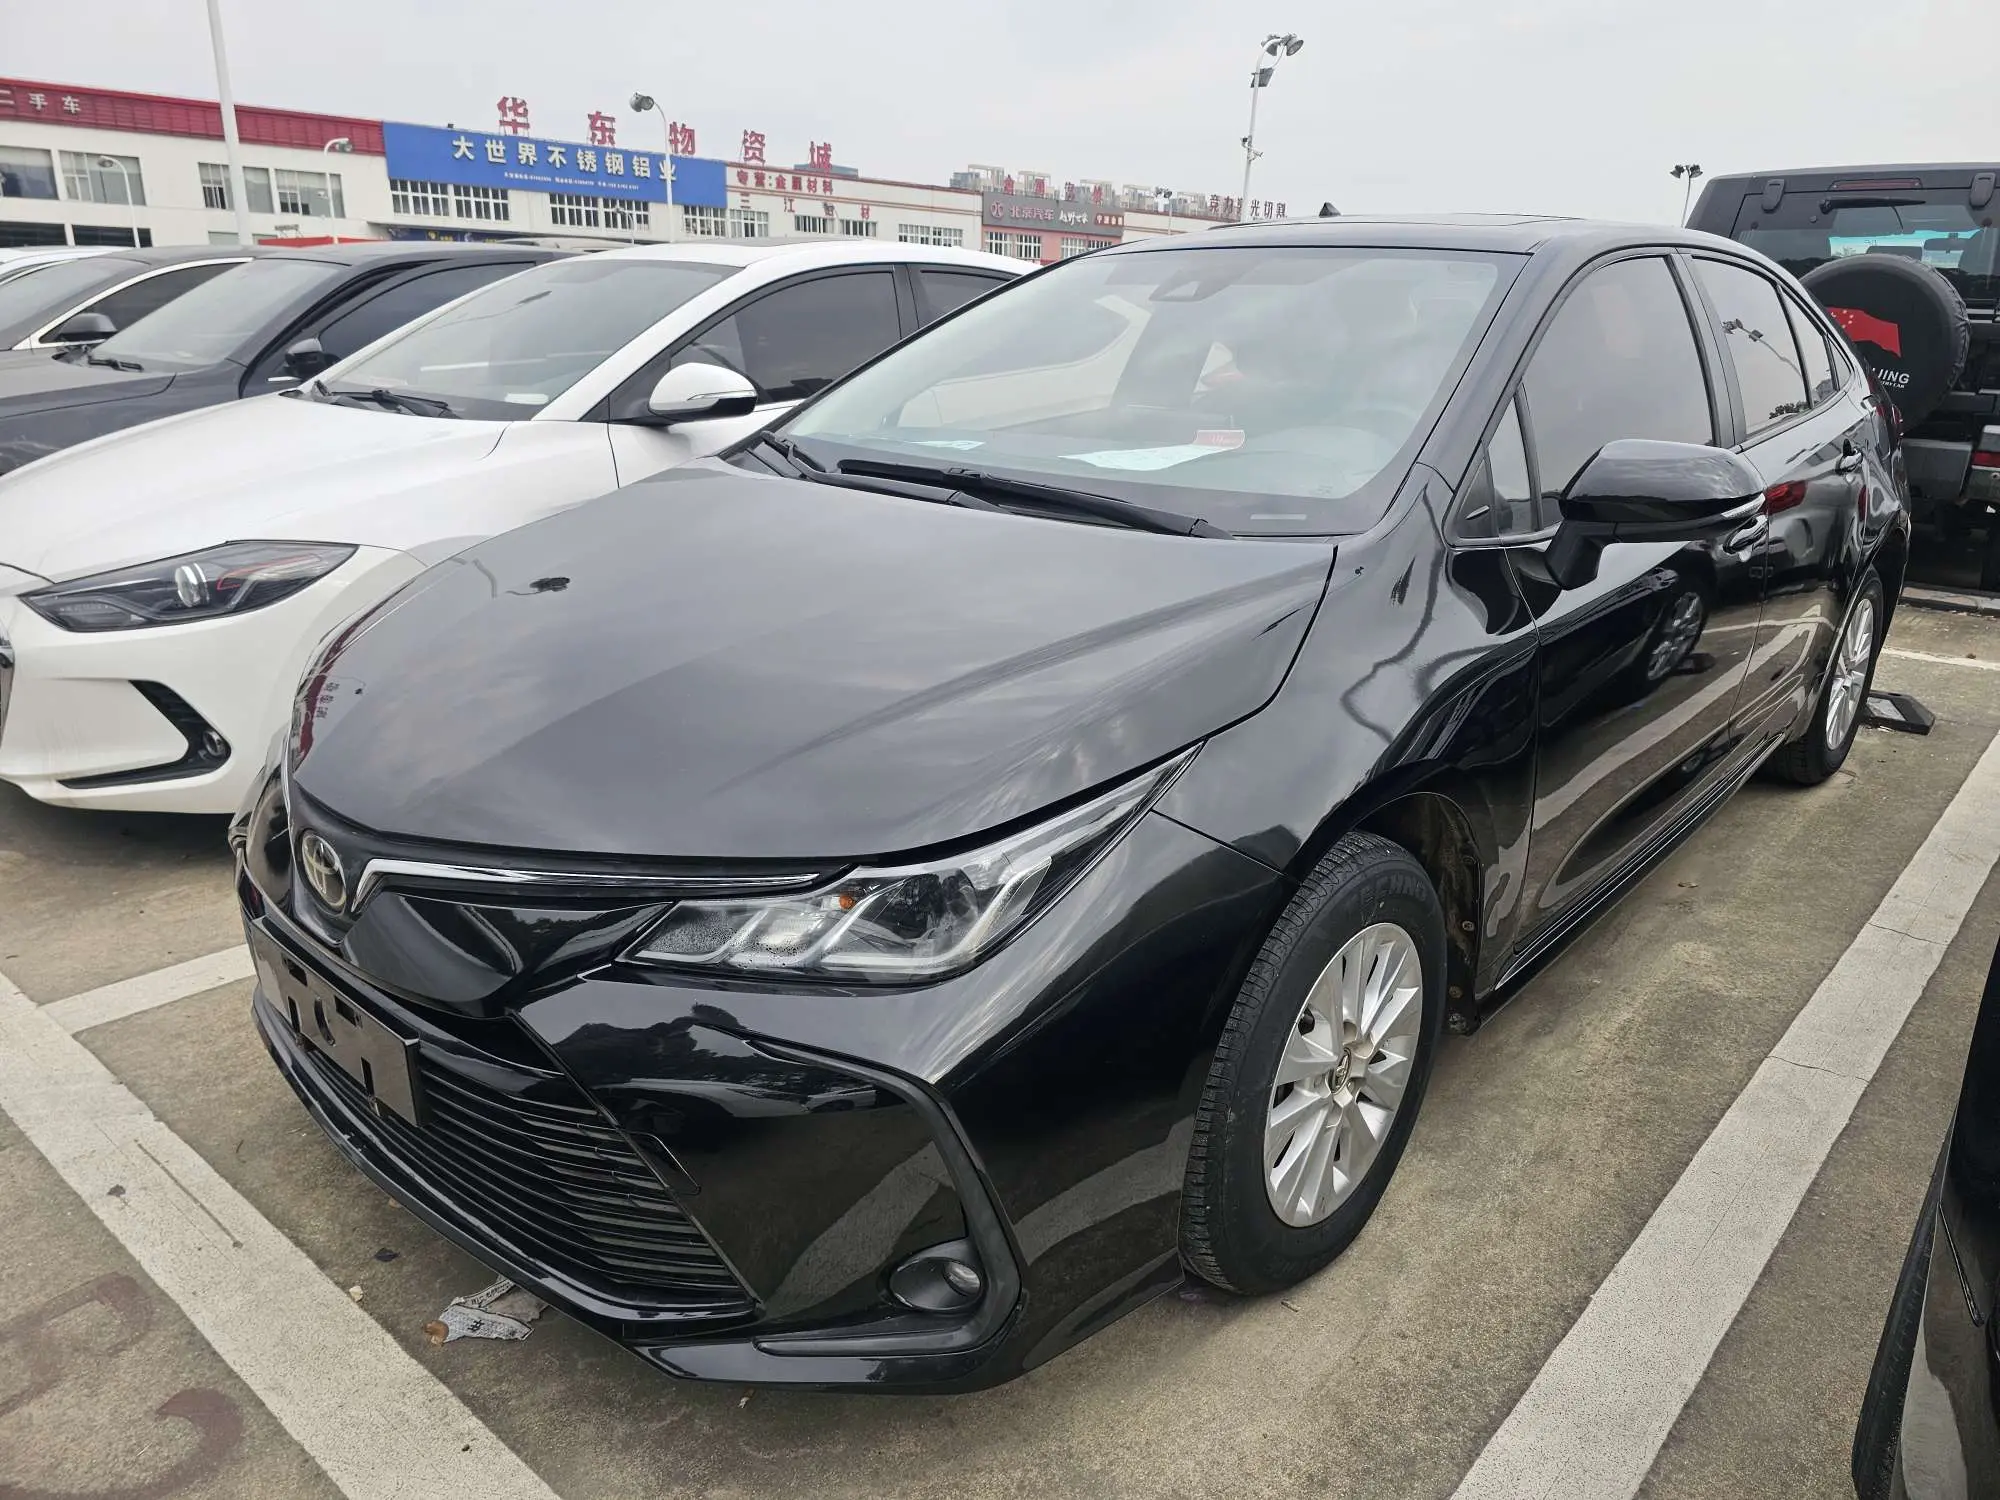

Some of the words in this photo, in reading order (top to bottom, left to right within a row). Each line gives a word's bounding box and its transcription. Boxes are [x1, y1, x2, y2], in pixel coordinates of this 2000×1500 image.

[0, 89, 82, 115] 二手车
[451, 135, 678, 182] 大世界不锈钢铝业
[1009, 206, 1055, 221] 北京汽车
